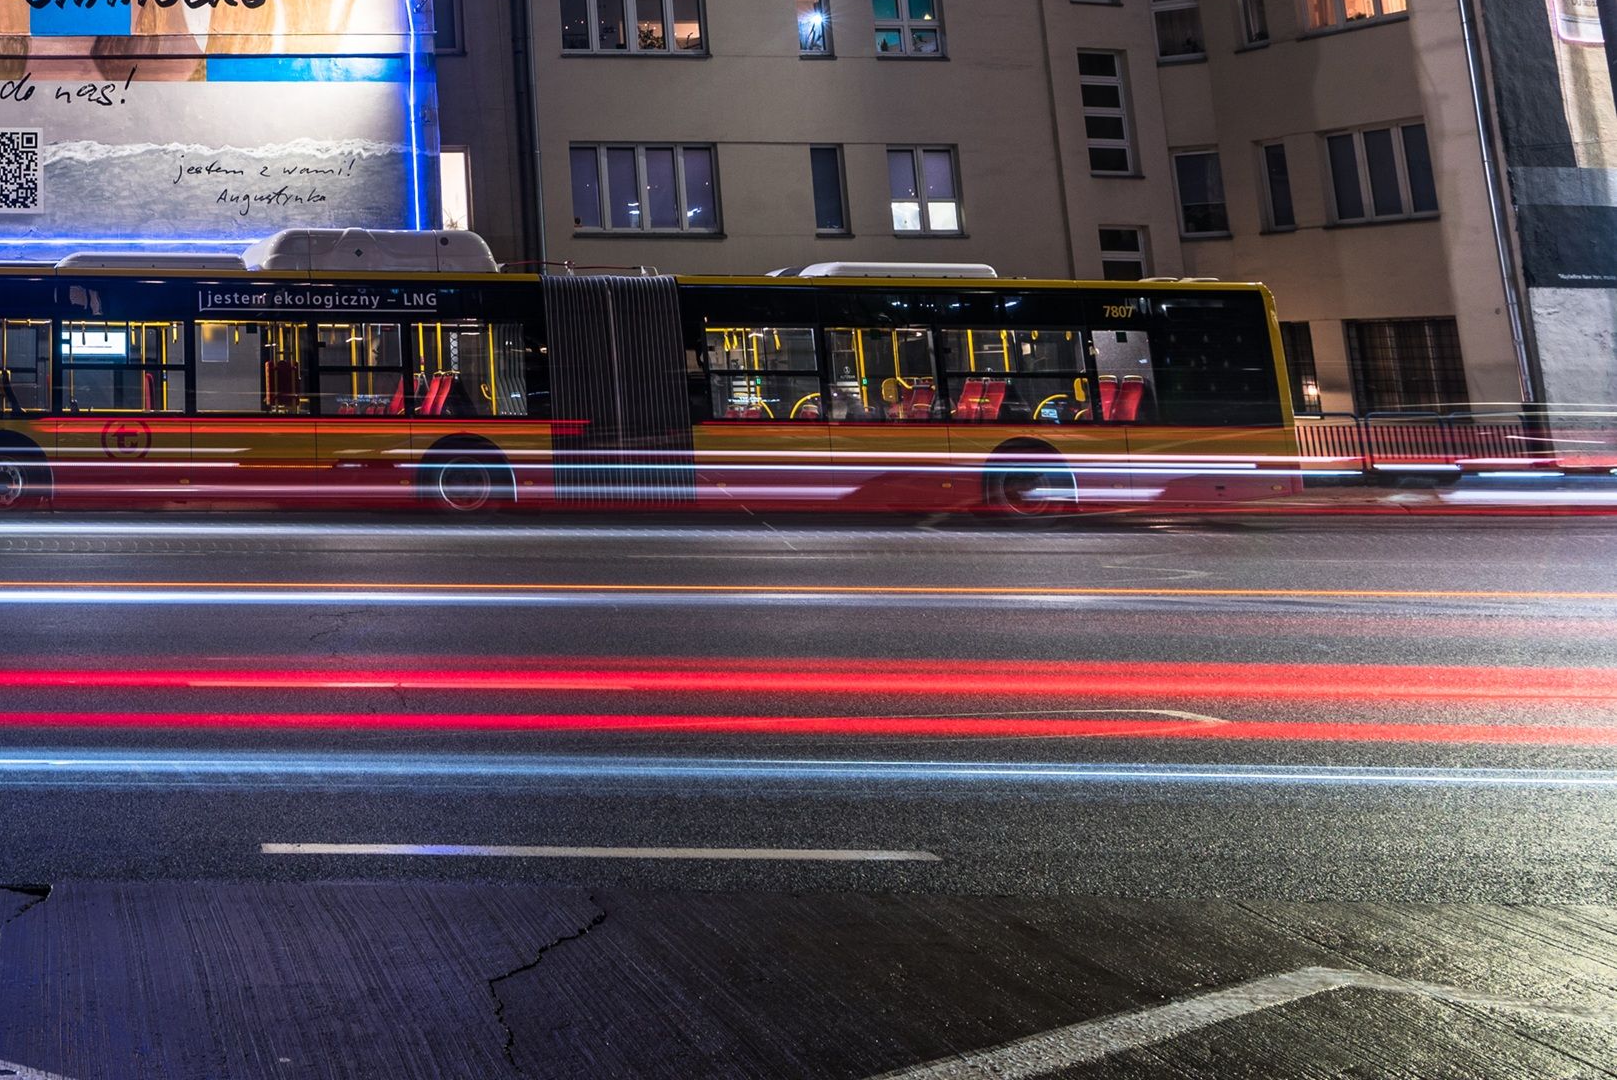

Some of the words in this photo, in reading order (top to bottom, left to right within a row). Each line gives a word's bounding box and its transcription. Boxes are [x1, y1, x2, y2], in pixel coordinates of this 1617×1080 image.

[0, 72, 35, 102] do
[55, 64, 137, 106] nas!
[173, 155, 244, 184] jestem
[207, 291, 266, 307] jestem
[274, 291, 380, 308] ekologiczny
[403, 293, 437, 306] LNG
[1103, 305, 1134, 318] 7807
